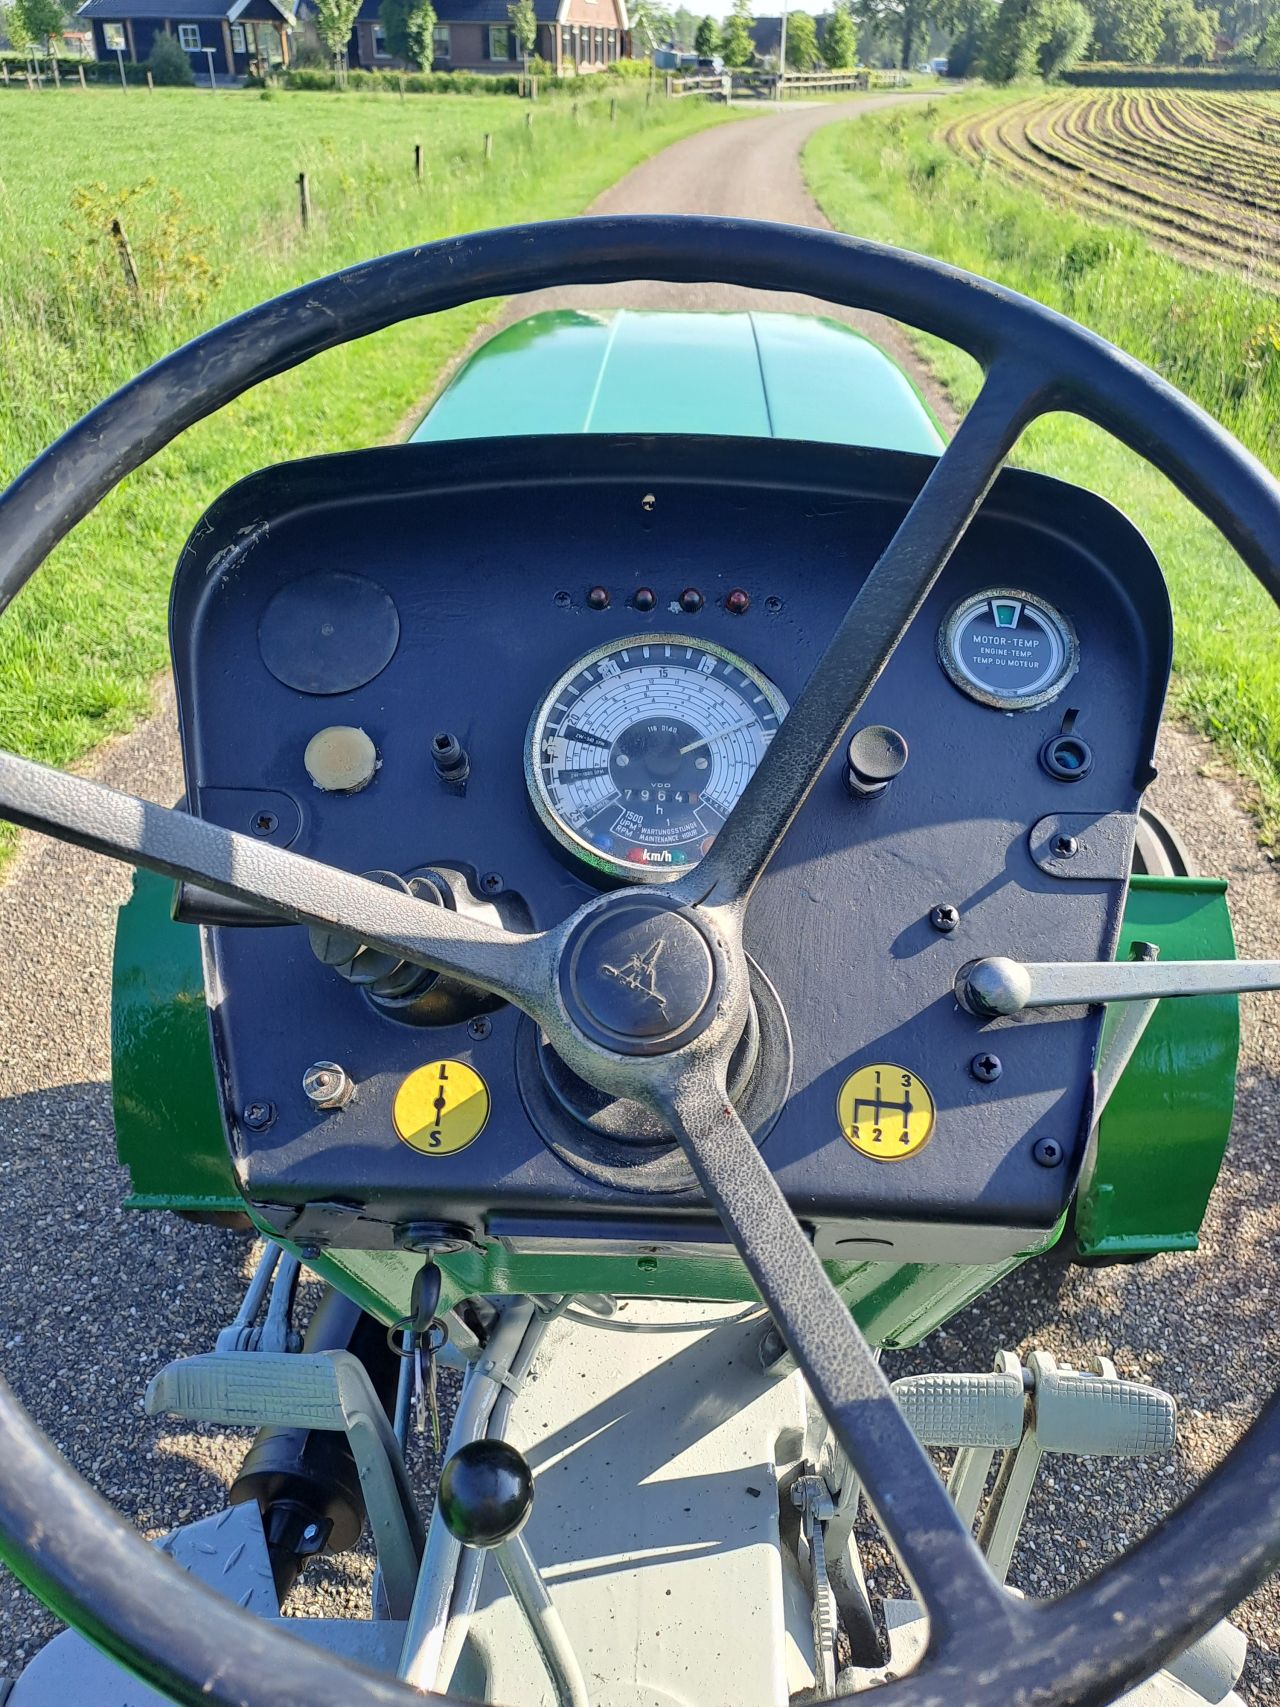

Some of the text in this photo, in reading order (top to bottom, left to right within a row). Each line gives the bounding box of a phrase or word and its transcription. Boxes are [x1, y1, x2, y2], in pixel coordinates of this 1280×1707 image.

[973, 656, 1040, 669] TEMP. DU MOTEUR
[659, 669, 669, 678] 15
[567, 713, 580, 726] 20
[656, 803, 664, 815] h
[569, 810, 582, 823] 25
[625, 810, 644, 824] 1500
[615, 824, 634, 838] RPM
[619, 818, 637, 831] UPM
[639, 829, 698, 843] MAINTENANCE HOUR
[643, 848, 672, 862] km/h
[439, 1063, 448, 1080] L
[874, 1070, 912, 1088] 1 3
[428, 1130, 442, 1148] S
[851, 1125, 910, 1145] R 2 4
